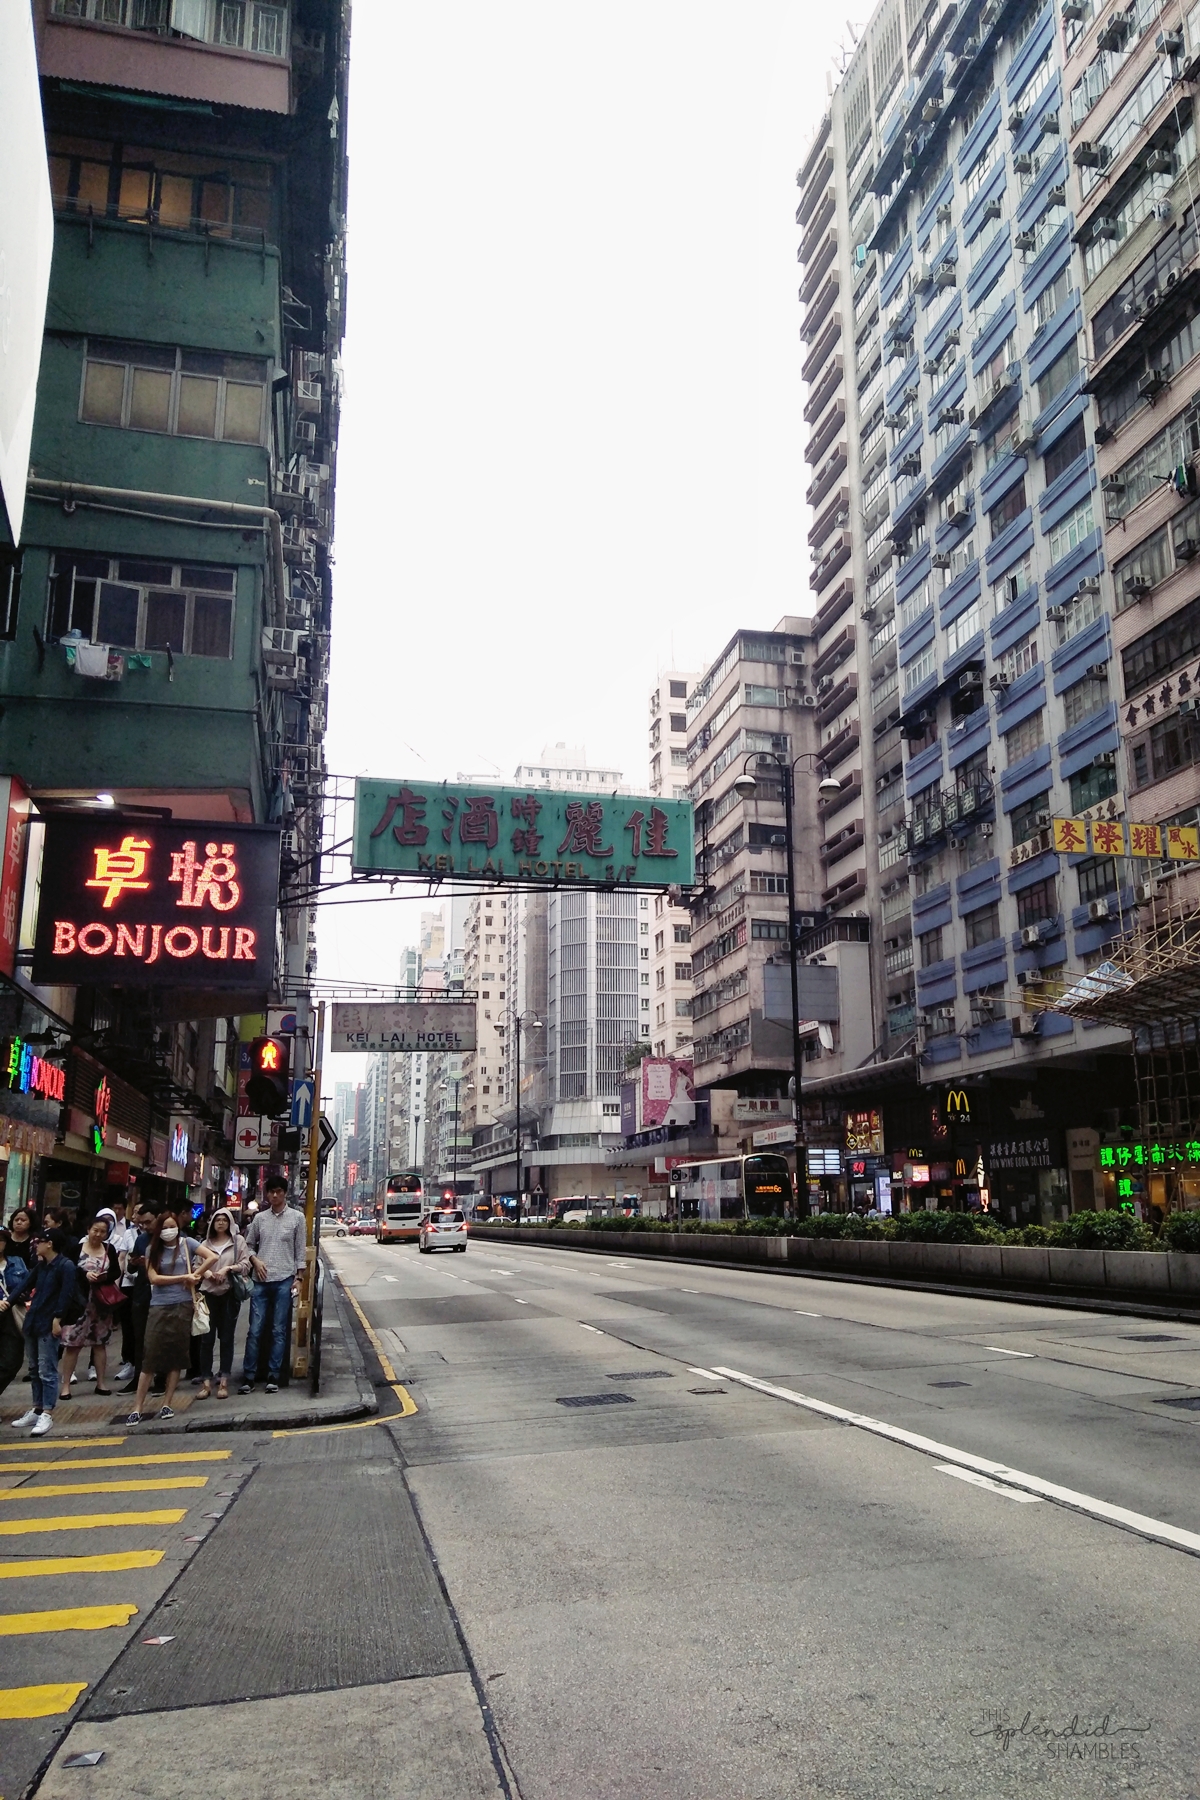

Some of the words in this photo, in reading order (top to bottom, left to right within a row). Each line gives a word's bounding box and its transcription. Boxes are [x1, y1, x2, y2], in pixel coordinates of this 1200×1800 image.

[84, 836, 242, 911] 卓悅
[417, 852, 455, 871] KEI
[468, 857, 504, 874] LAI
[519, 860, 590, 878] HOTEL
[604, 864, 637, 882] 2/F
[52, 921, 257, 964] BONJOUR
[346, 1033, 369, 1042] KEI
[381, 1033, 405, 1042] LAI
[417, 1033, 462, 1042] HOTEL
[960, 1113, 971, 1123] 24
